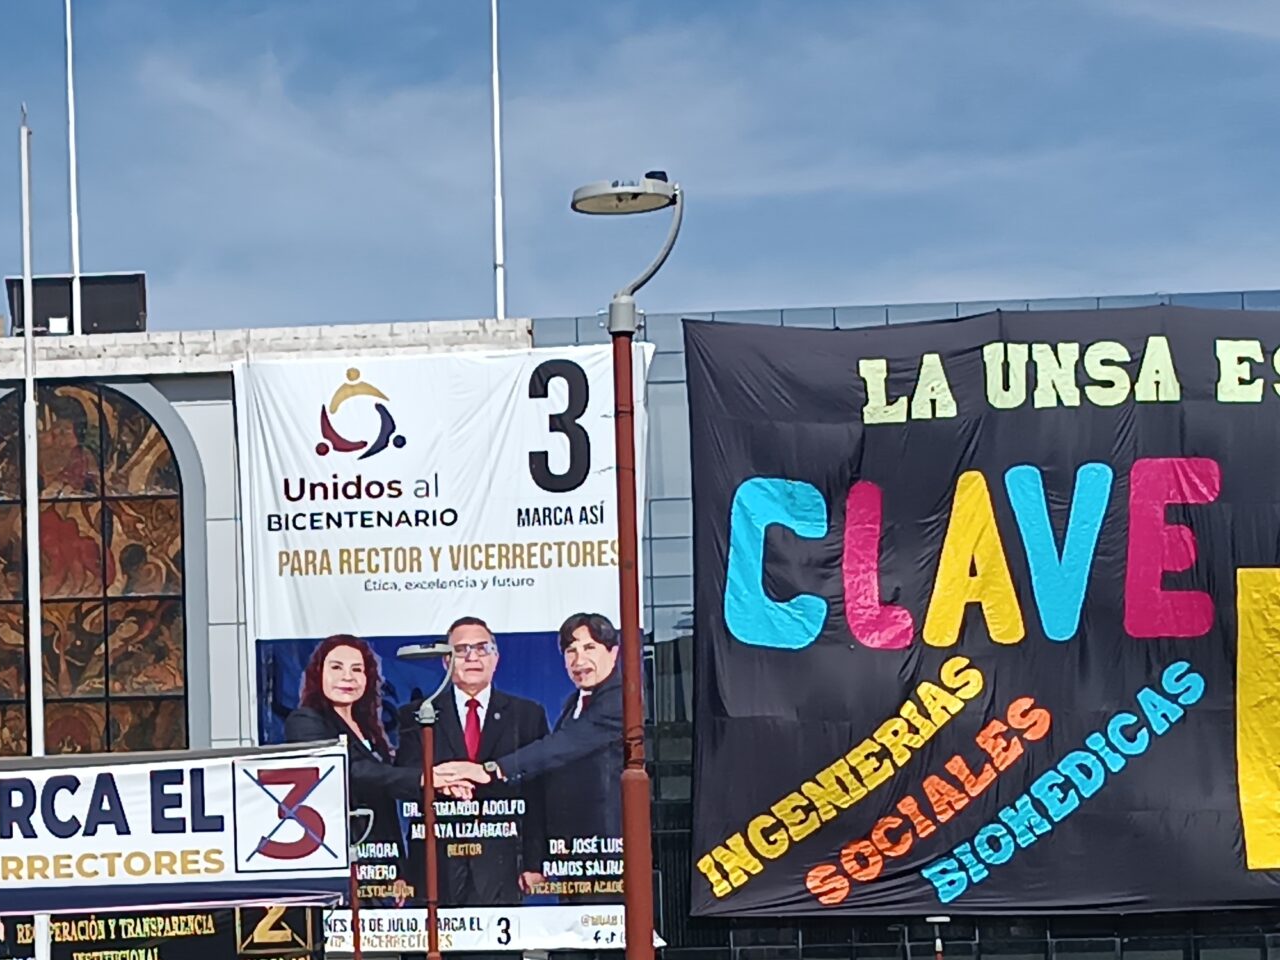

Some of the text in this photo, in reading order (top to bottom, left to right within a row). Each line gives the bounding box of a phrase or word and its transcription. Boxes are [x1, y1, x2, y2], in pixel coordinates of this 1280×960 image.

[858, 335, 1280, 424] LA UNSA E
[528, 359, 591, 493] 3
[283, 473, 439, 502] Unidos al
[267, 509, 458, 531] BICENTENARIO
[517, 500, 605, 528] MARCA ASÍ
[278, 549, 332, 577] PARA
[338, 546, 422, 575] RECTOR
[429, 546, 444, 571] Y
[723, 457, 1221, 650] CLAVE
[405, 576, 477, 592] excelencia
[481, 578, 489, 591] y
[492, 574, 535, 588] futuro
[696, 656, 984, 898] INGENIERIAS
[921, 660, 1205, 904] BIOMEDICAS
[150, 768, 224, 833] EL
[256, 767, 326, 859] 3
[482, 799, 526, 815] ADOLFO
[805, 696, 1052, 906] SOCIALES
[357, 842, 399, 859] URORA
[447, 842, 482, 858] RECTOR
[549, 838, 570, 855] DR.
[572, 835, 598, 856] JOSÉ
[543, 860, 583, 878] RAMOS
[108, 919, 117, 940] Y
[119, 913, 215, 939] TRANSPARENCIA
[370, 917, 383, 931] DE
[470, 917, 483, 931] EL
[496, 917, 511, 945] 3
